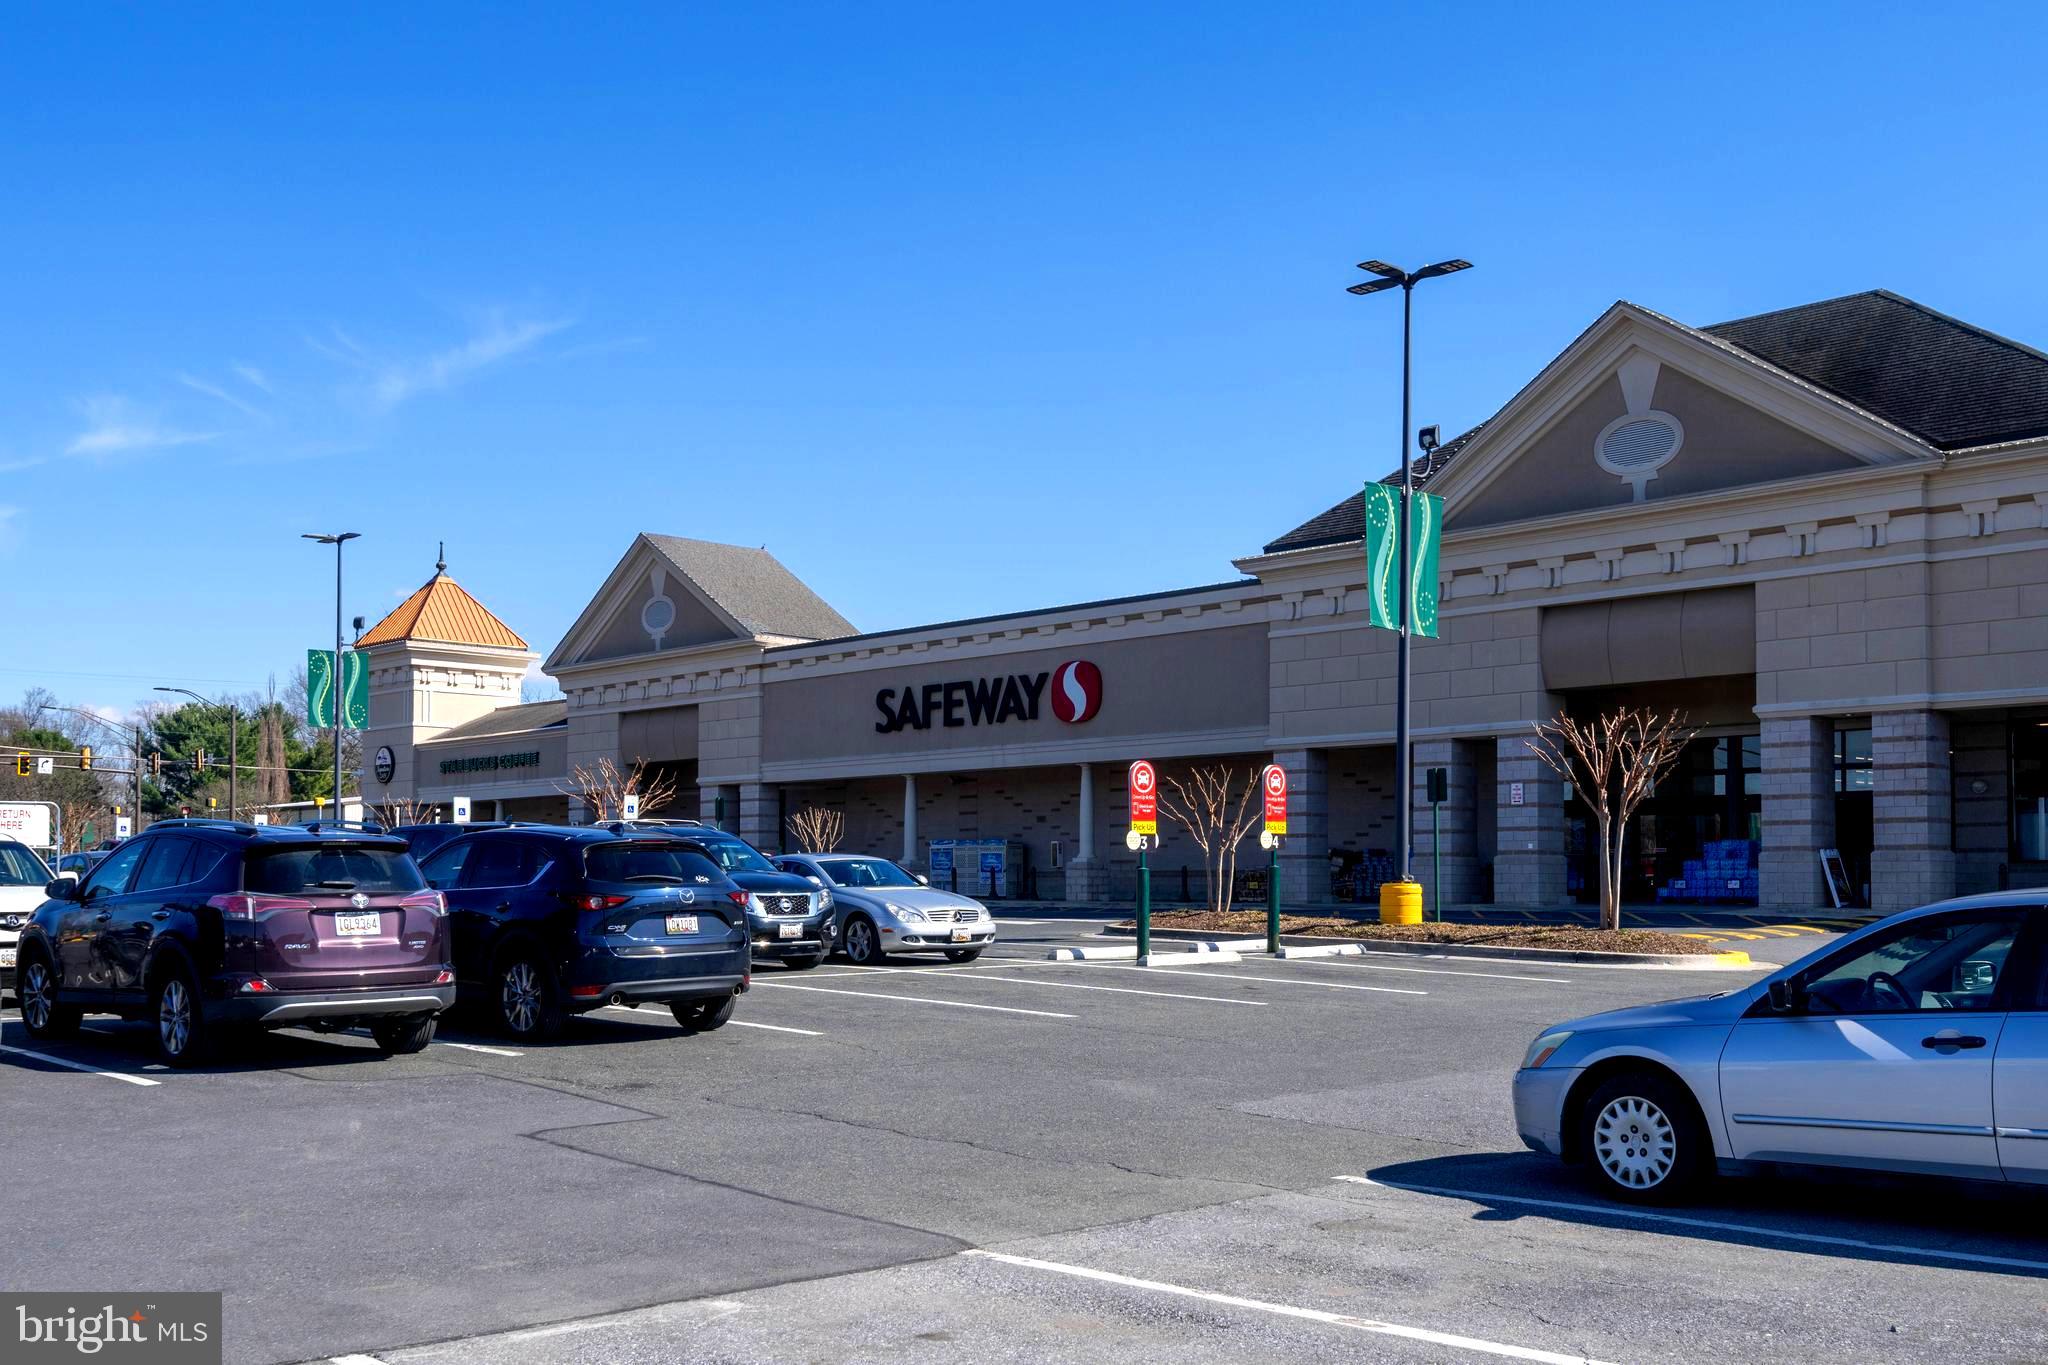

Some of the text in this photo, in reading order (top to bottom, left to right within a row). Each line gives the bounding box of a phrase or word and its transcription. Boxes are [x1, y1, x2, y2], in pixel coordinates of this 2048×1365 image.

[875, 672, 1049, 733] SAFEWAY
[0, 820, 23, 830] HERE
[1133, 823, 1155, 832] Pick Up
[1266, 823, 1277, 831] Pick
[1140, 835, 1148, 850] 3
[1272, 835, 1280, 849] 4
